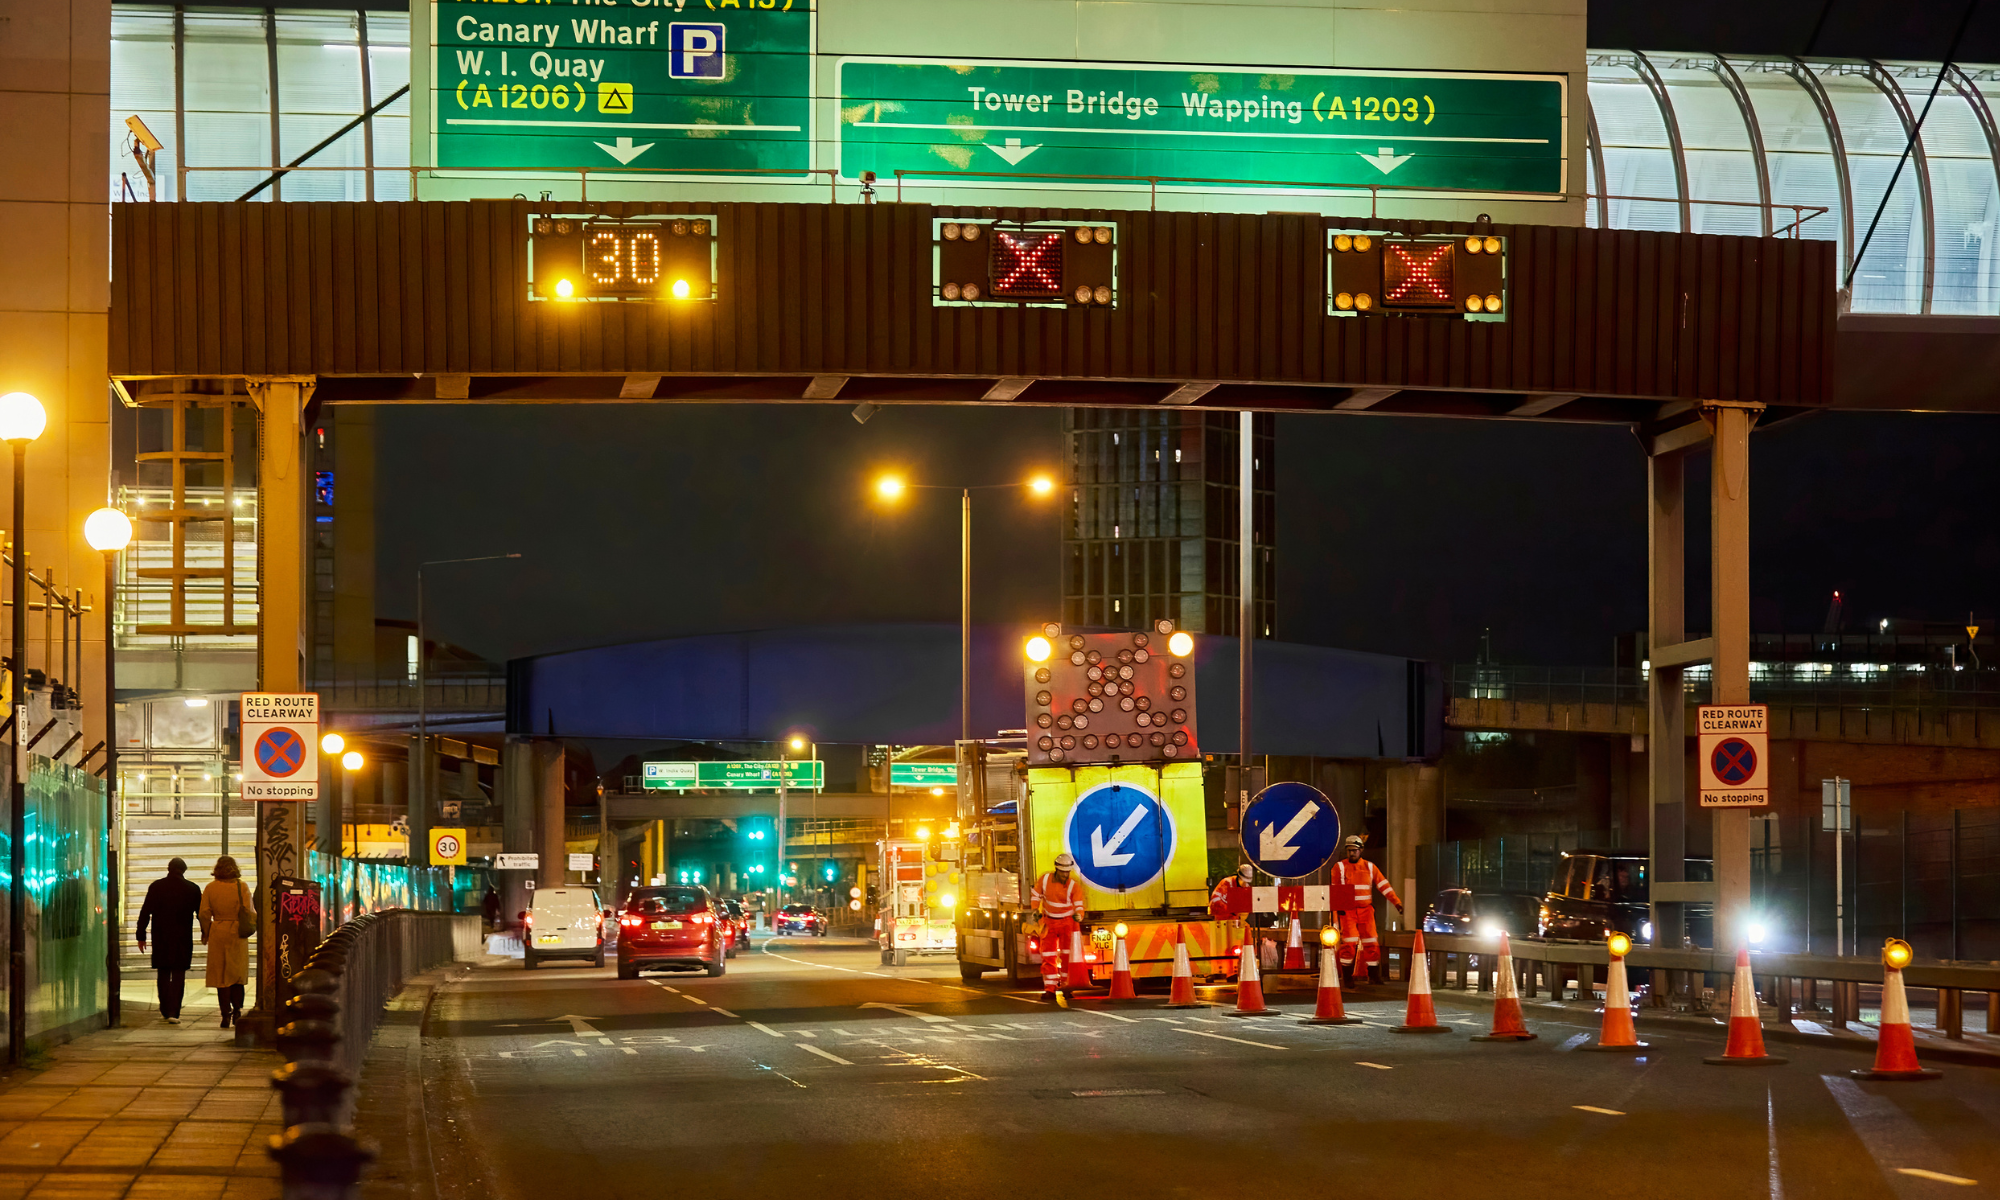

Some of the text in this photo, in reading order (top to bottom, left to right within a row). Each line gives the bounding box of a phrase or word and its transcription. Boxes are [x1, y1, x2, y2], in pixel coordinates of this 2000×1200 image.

[456, 15, 659, 47] Canary Wharf
[683, 29, 717, 74] P
[456, 50, 605, 82] W. I. Quay
[456, 79, 586, 112] (A1206)
[968, 86, 1435, 125] Tower Bridge Wapping (A1203)
[592, 232, 660, 283] 30
[246, 697, 315, 707] RED ROUTE
[247, 708, 313, 718] CLEARWAY
[1702, 709, 1763, 719] RED ROUTE
[1703, 720, 1763, 729] CLEARWAY
[247, 785, 314, 797] No stopping
[1704, 792, 1764, 804] No stopping
[439, 842, 457, 852] 30
[1091, 933, 1112, 942] FN20
[1094, 942, 1110, 950] XLG
